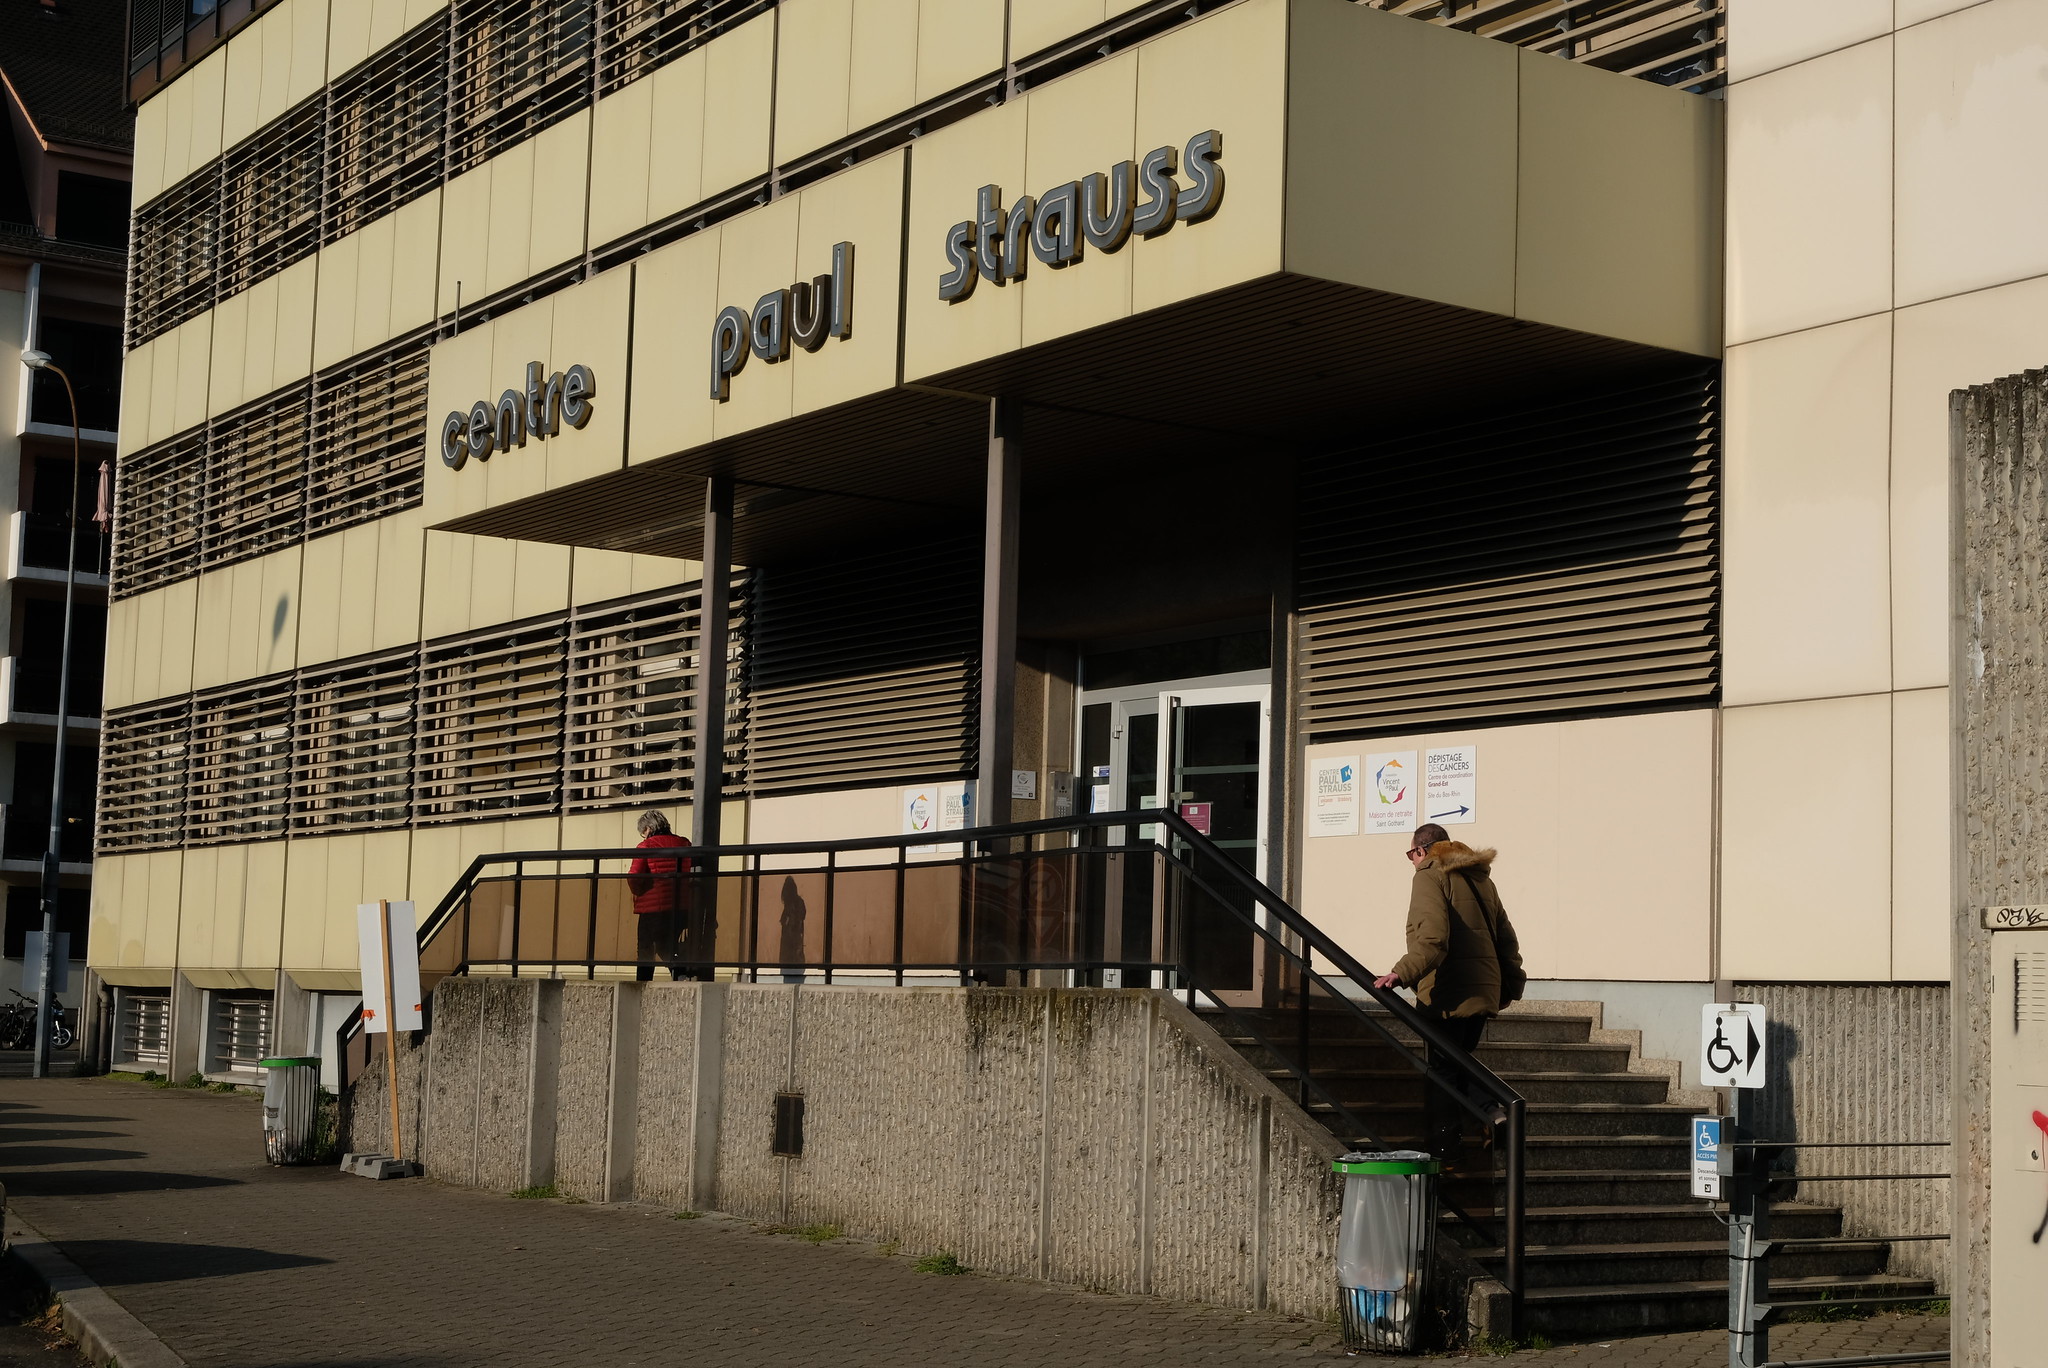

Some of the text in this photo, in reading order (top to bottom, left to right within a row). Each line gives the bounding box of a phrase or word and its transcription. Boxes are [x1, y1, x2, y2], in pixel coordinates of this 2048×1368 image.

[441, 129, 1224, 470] centre paul strauss
[1428, 753, 1462, 763] DÉPISTAGE
[1319, 768, 1339, 776] CENTRE
[1318, 775, 1339, 785] PAUL
[1318, 783, 1352, 794] STRAUSS
[946, 801, 961, 809] PAUL
